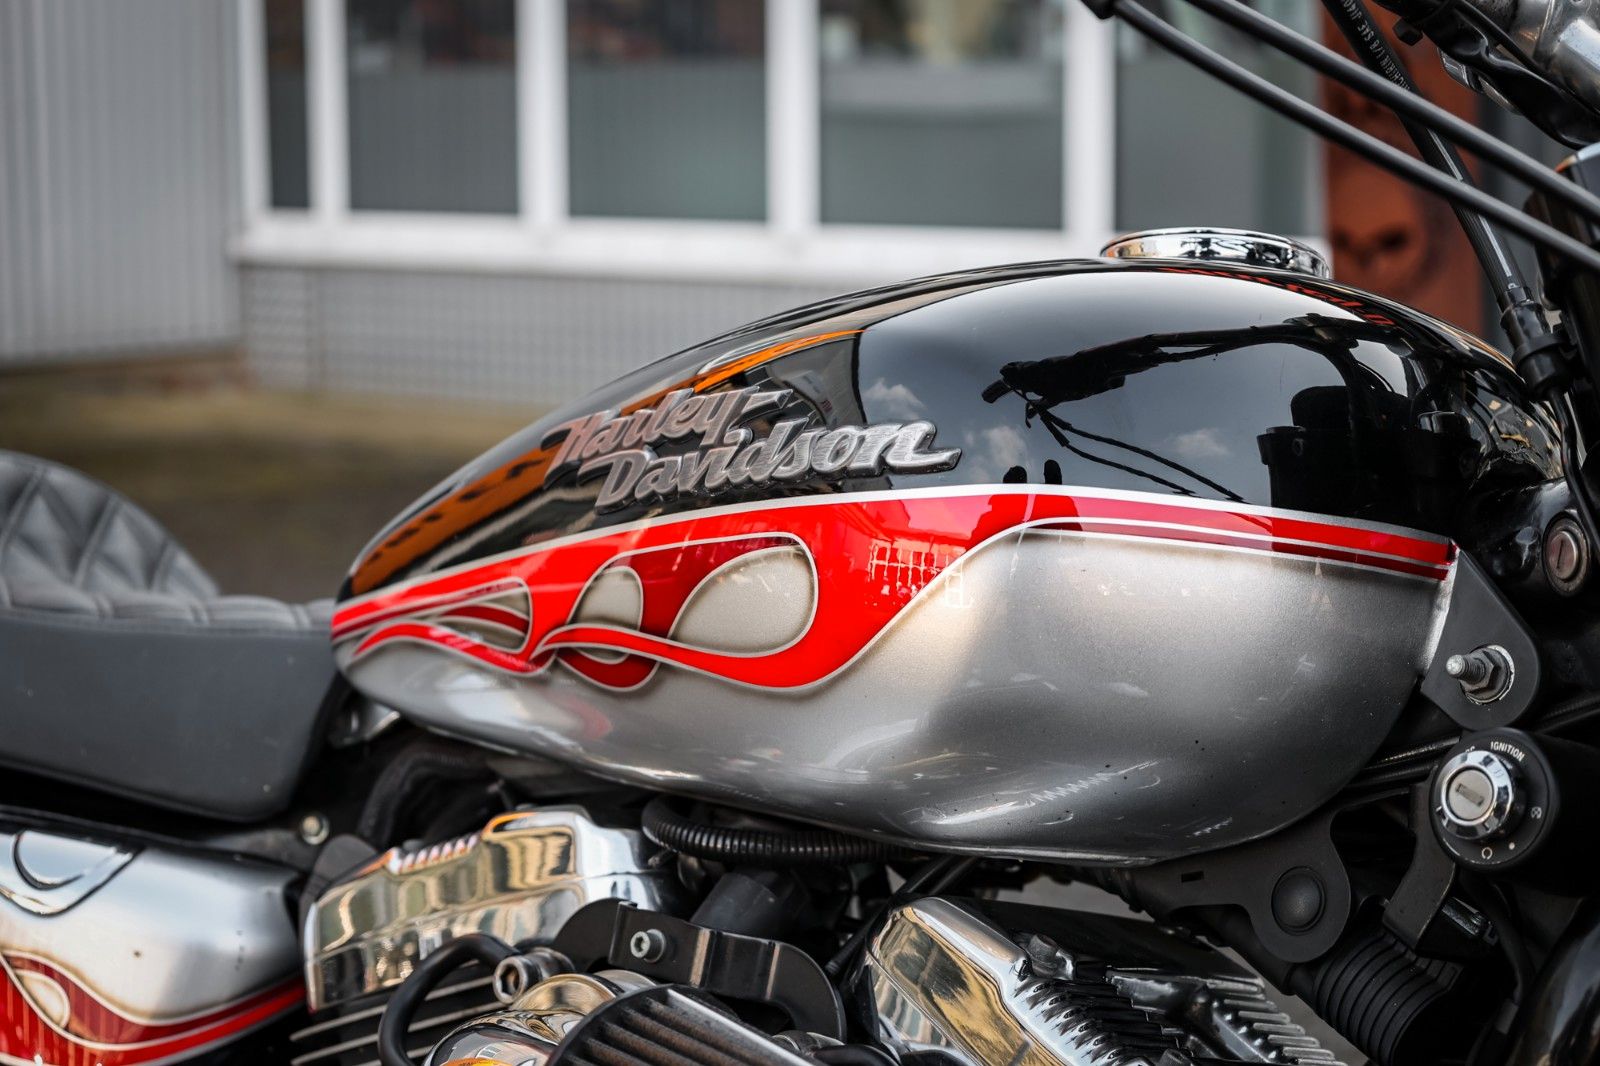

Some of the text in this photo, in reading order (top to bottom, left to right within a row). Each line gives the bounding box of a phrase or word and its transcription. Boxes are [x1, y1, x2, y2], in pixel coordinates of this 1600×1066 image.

[1342, 0, 1362, 20] J140
[1357, 20, 1375, 41] SAE
[578, 417, 963, 515] Davidson
[1490, 741, 1525, 762] IGNITION
